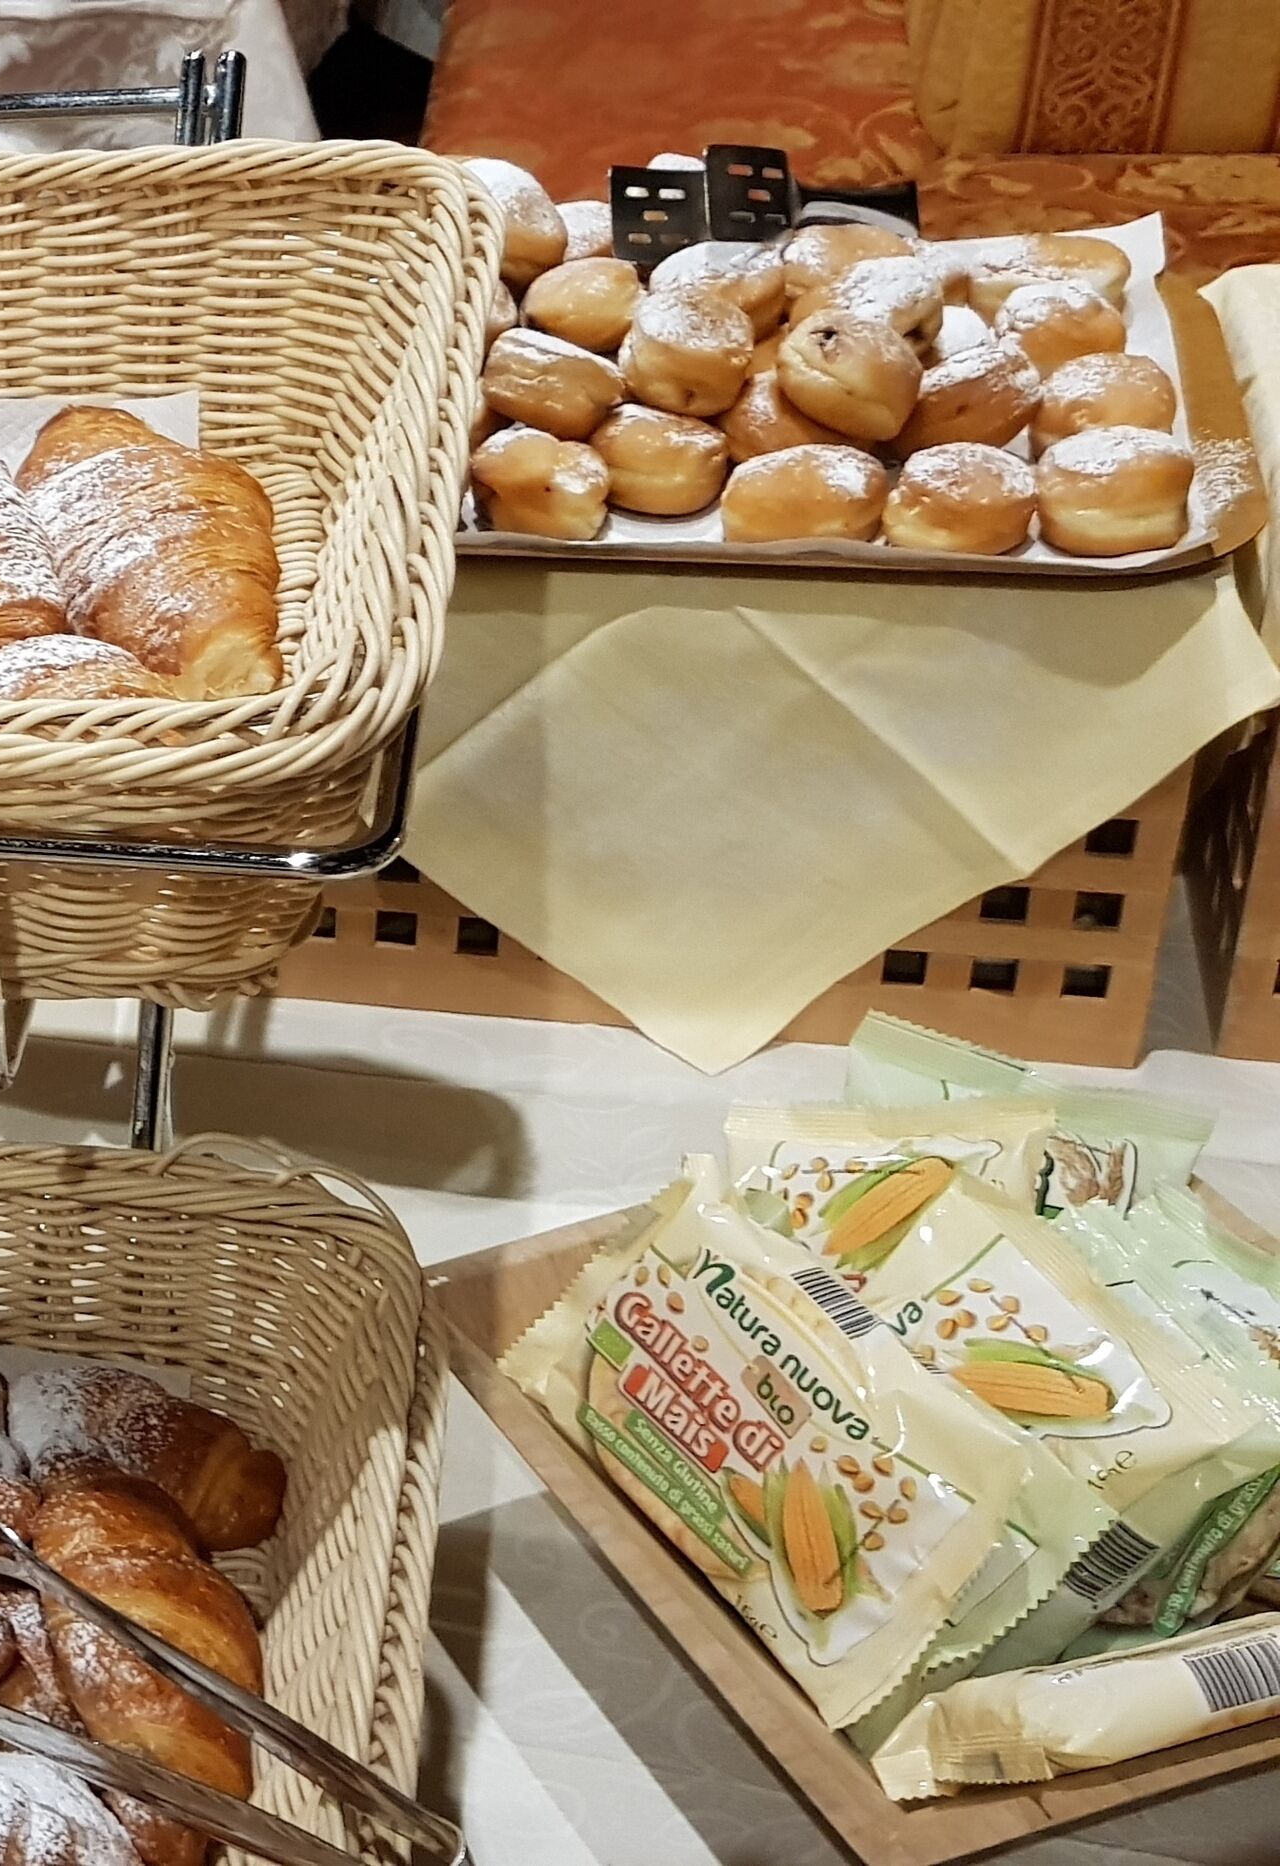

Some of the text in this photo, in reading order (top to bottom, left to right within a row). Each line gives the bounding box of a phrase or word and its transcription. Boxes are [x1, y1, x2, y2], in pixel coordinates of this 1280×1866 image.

[639, 1371, 718, 1459] Mais
[756, 1373, 795, 1426] bio
[778, 1353, 871, 1441] nuova
[634, 1417, 719, 1515] Senza Glutine
[739, 1421, 783, 1470] di
[668, 1487, 685, 1504] di
